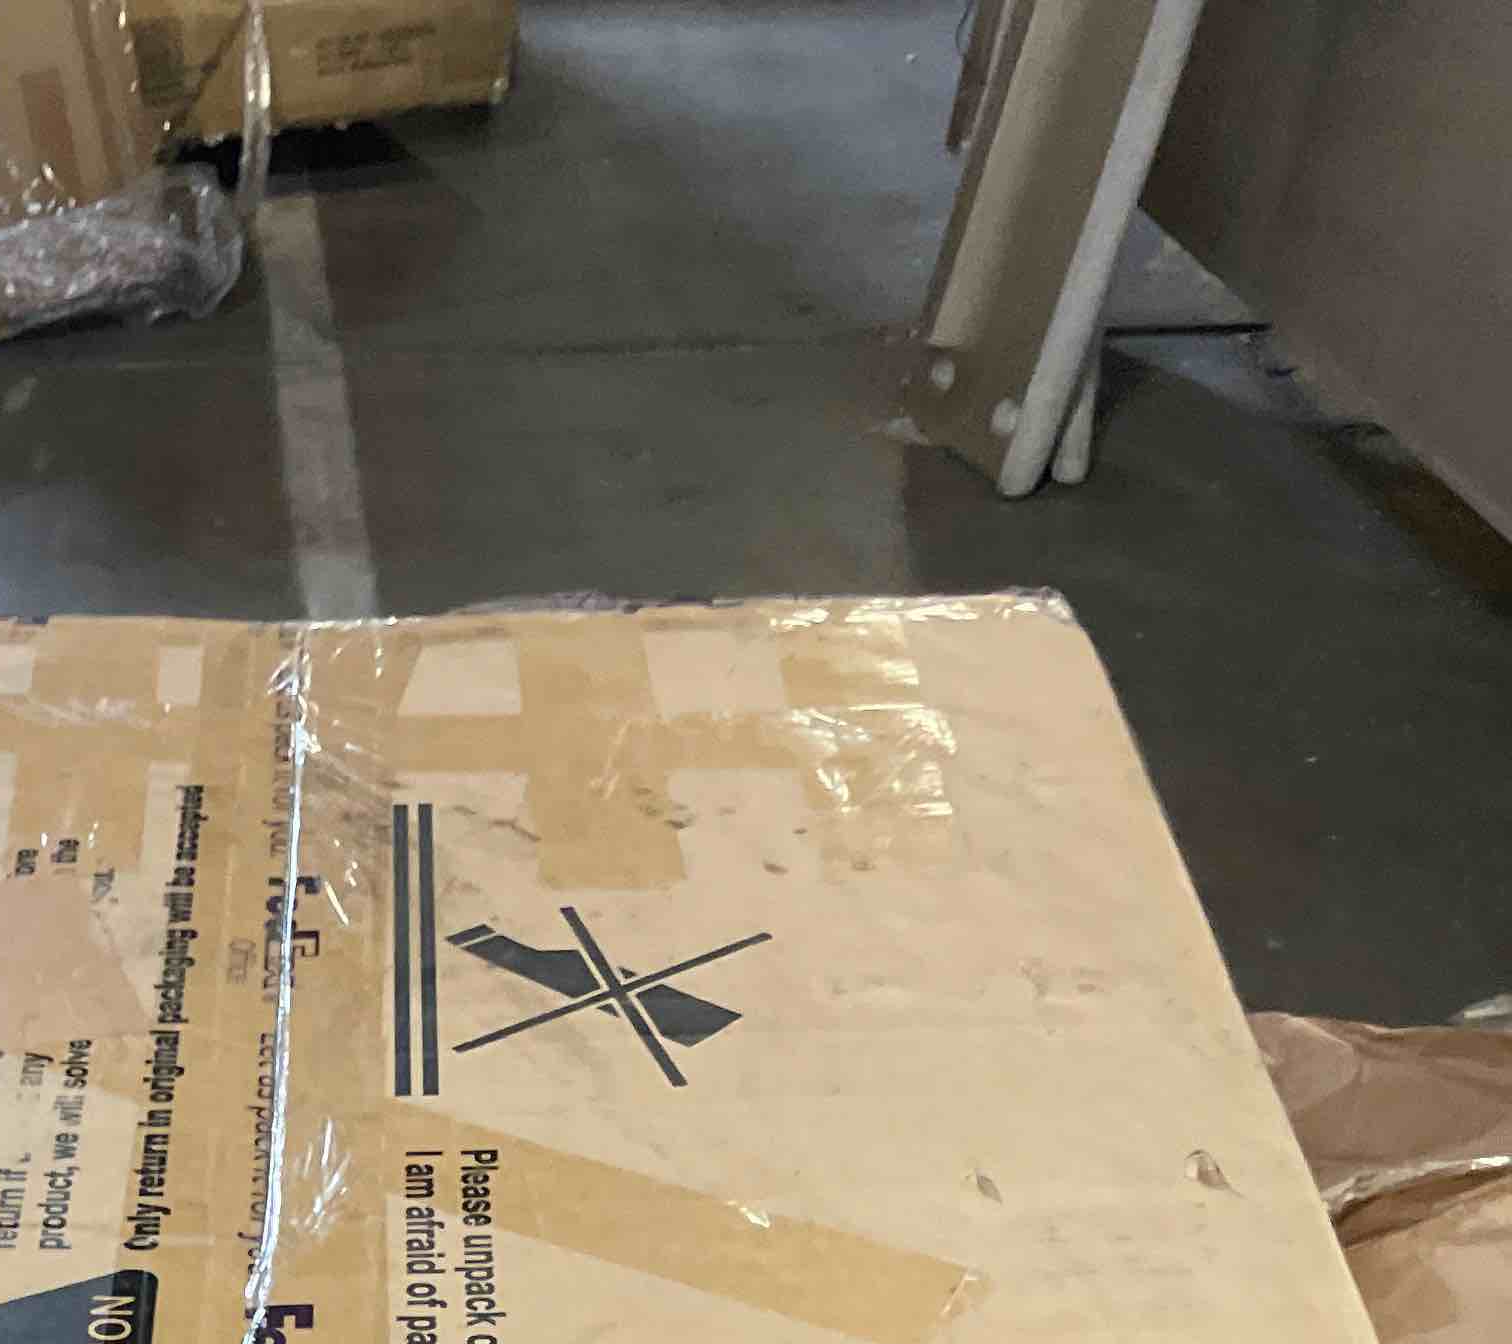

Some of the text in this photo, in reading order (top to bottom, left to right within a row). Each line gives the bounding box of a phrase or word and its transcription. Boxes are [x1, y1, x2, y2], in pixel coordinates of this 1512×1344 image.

[123, 784, 209, 1250] Only return in original packaging will be accepted
[20, 1052, 55, 1087] any
[61, 1039, 93, 1089] solve
[54, 1132, 79, 1161] we
[37, 1166, 81, 1250] product,
[405, 1163, 435, 1199] am
[460, 1149, 500, 1227] Please
[405, 1206, 446, 1274] afraid
[406, 1282, 448, 1309] of
[454, 1235, 507, 1327] unpack
